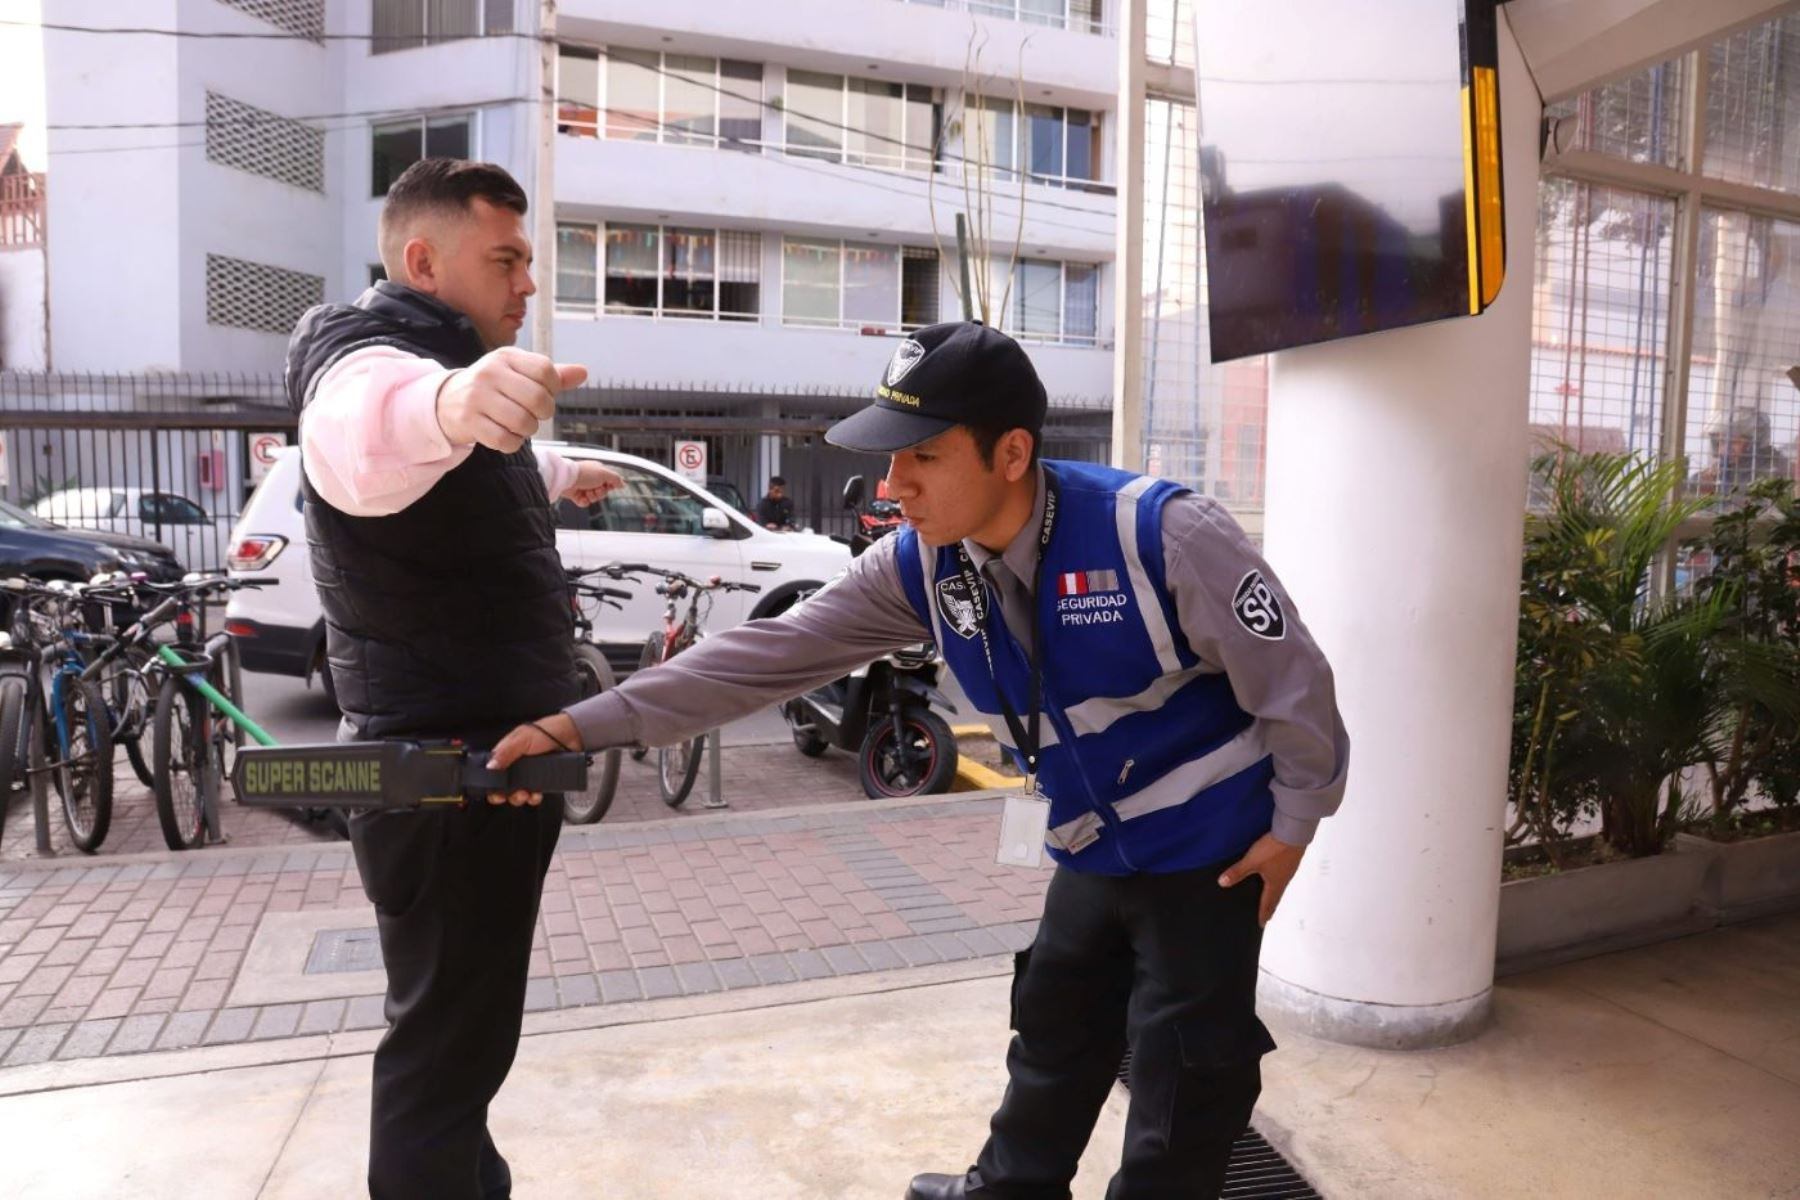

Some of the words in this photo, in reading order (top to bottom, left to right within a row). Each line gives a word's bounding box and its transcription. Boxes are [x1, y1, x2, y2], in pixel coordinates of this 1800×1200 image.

[1042, 490, 1056, 544] CASEVIP
[964, 570, 984, 620] CASEVIP
[1062, 610, 1123, 625] PRIVADA
[1243, 583, 1278, 632] SP
[246, 761, 305, 792] SUPER
[309, 760, 381, 792] SCANNE
